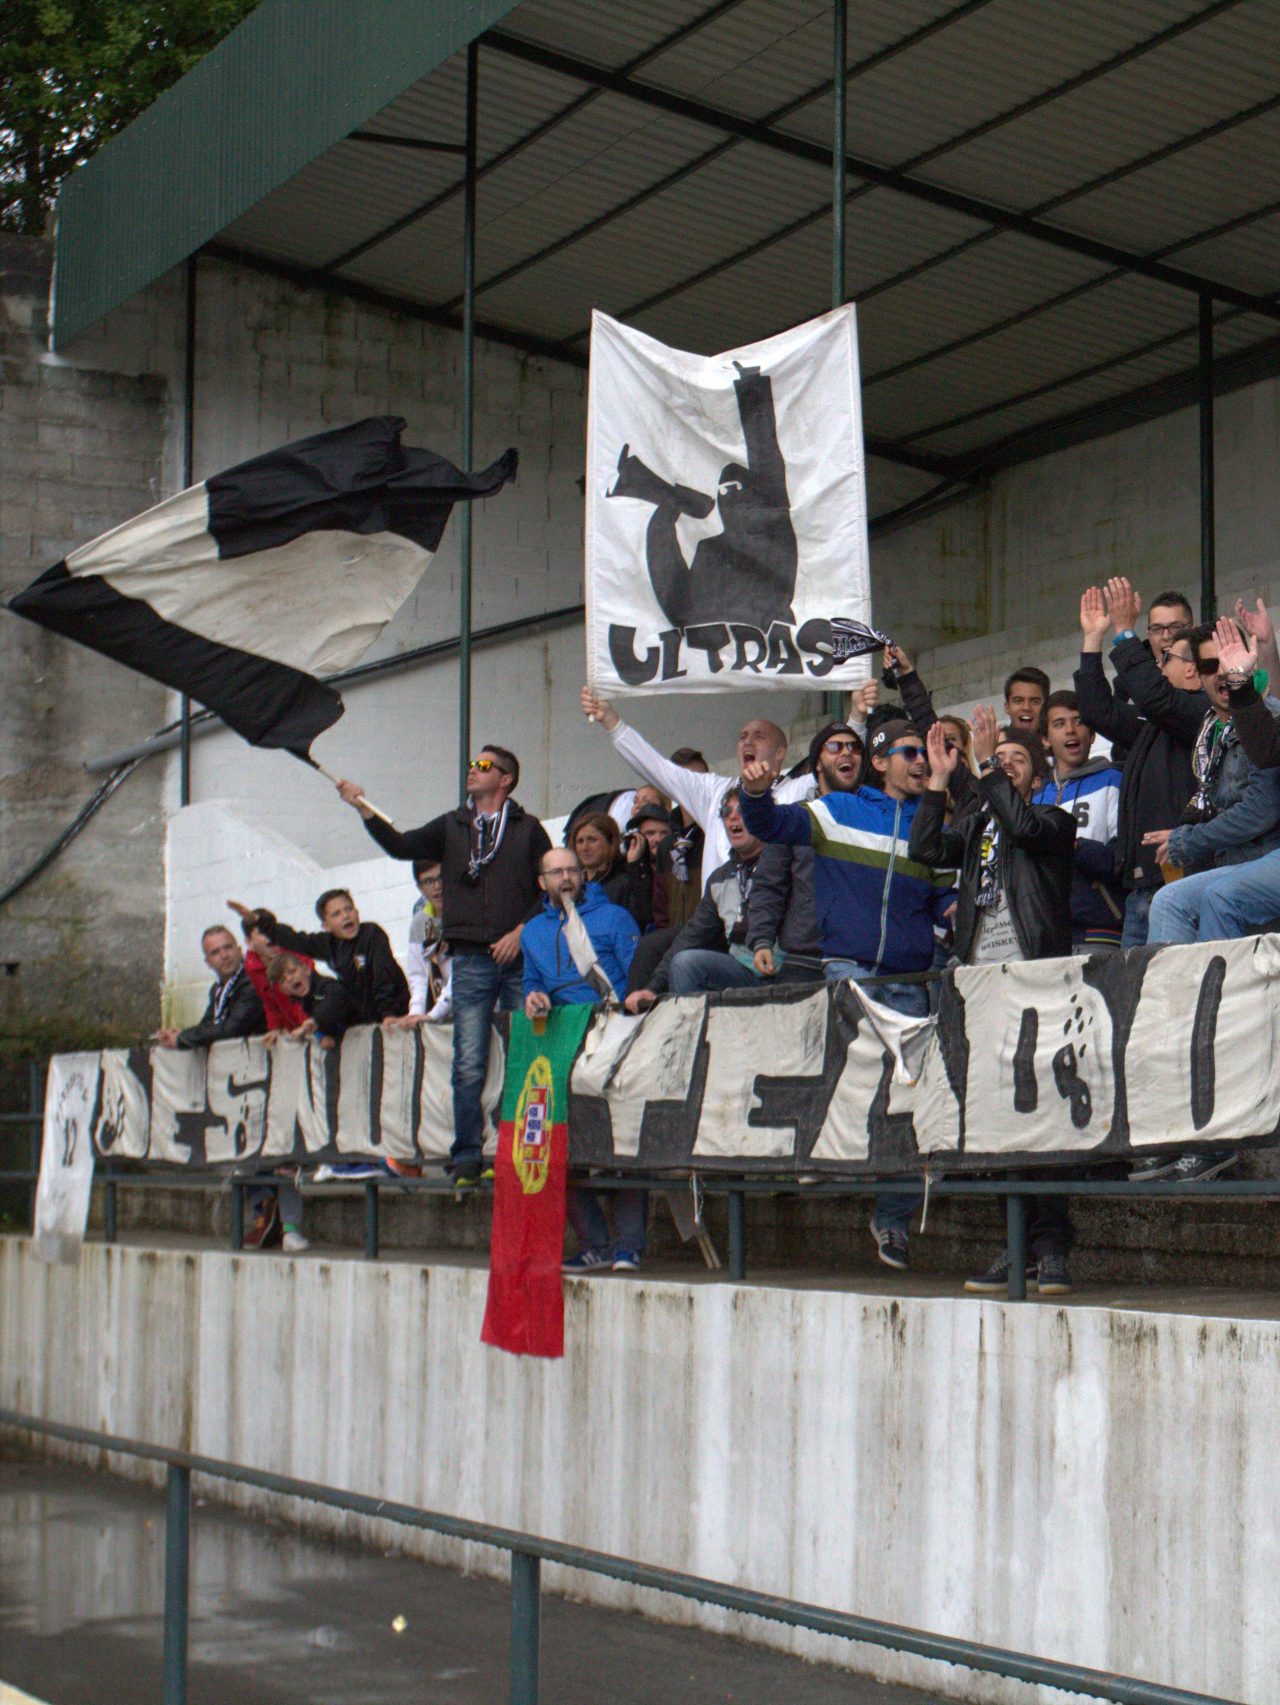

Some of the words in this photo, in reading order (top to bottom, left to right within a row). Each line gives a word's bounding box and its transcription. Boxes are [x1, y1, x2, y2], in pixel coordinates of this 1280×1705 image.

[608, 618, 834, 686] ULTRAS
[873, 732, 885, 747] 90
[981, 937, 1017, 951] WHISKE
